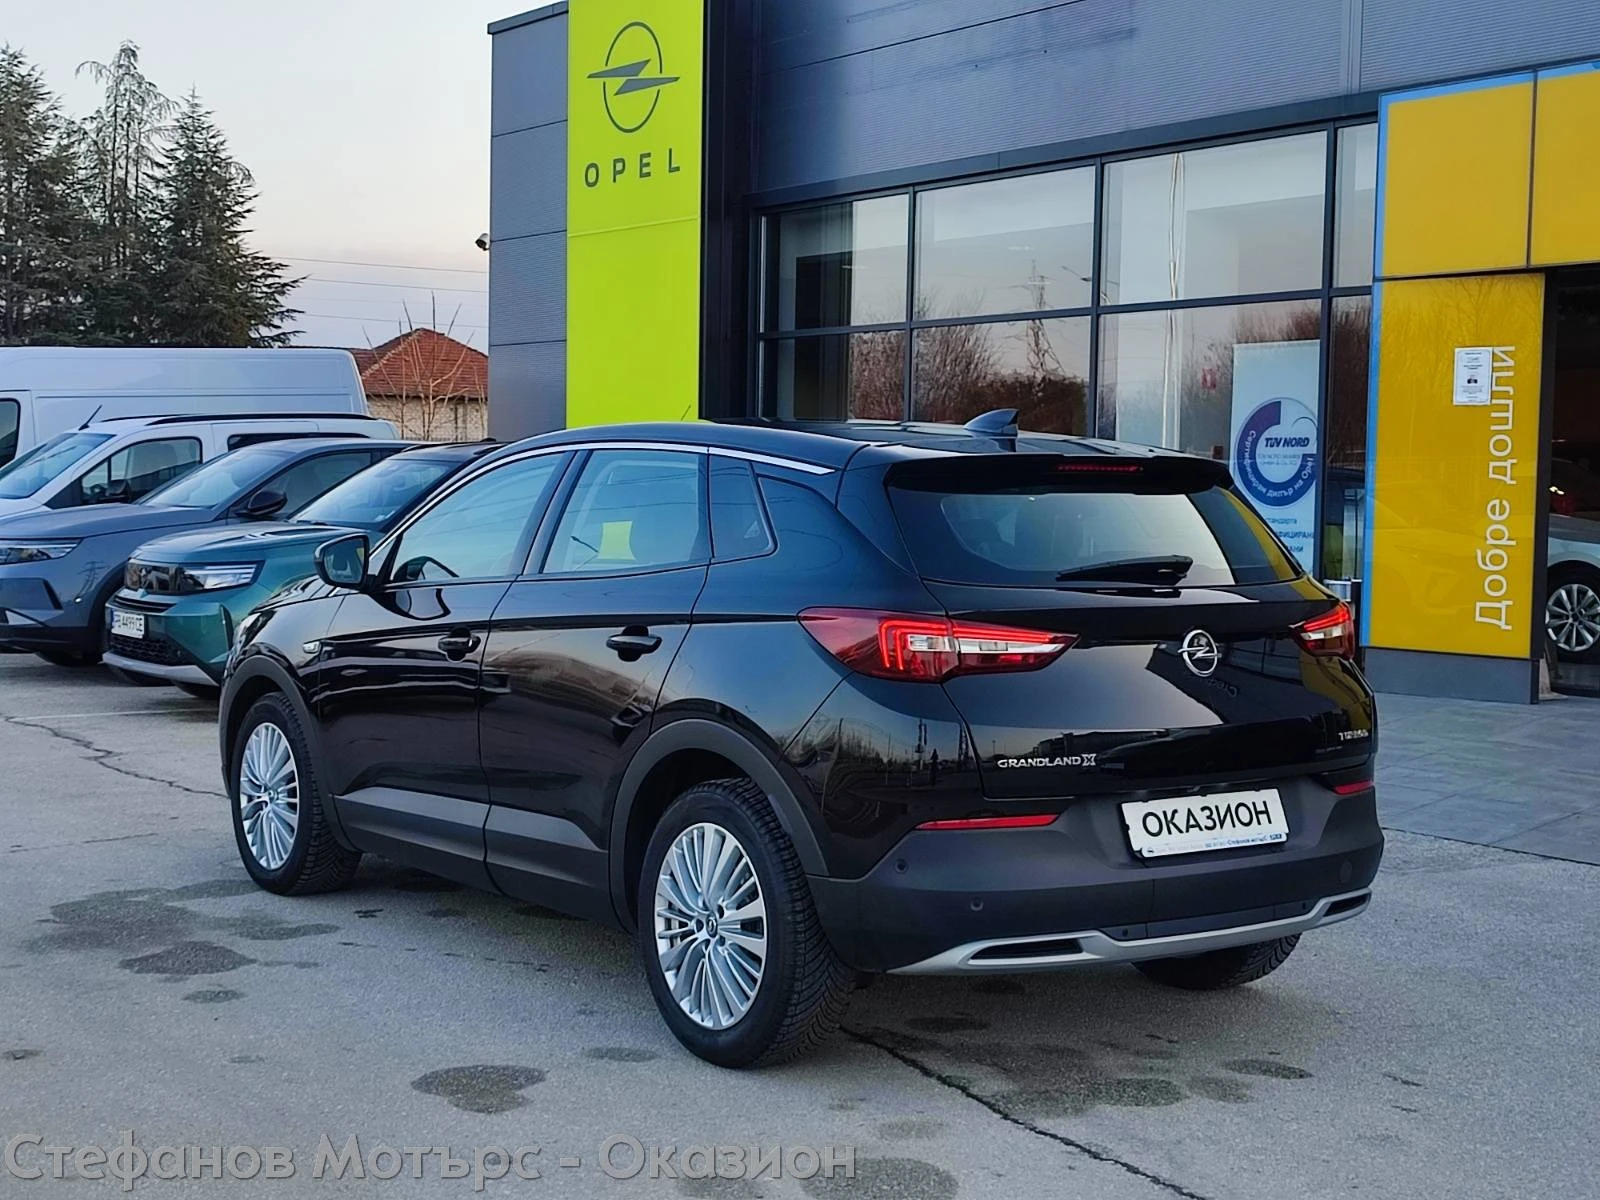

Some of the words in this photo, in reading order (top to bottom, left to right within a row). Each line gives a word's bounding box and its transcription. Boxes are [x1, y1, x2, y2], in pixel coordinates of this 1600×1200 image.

[584, 148, 681, 188] OPEL
[1488, 346, 1518, 485] дошли
[1264, 436, 1282, 448] TÜV
[1282, 436, 1310, 448] NORD
[1301, 457, 1315, 479] Opel
[1475, 498, 1517, 631] Добре
[997, 756, 1081, 768] GRANDLAND
[1142, 800, 1273, 838] ОКАЗИОН
